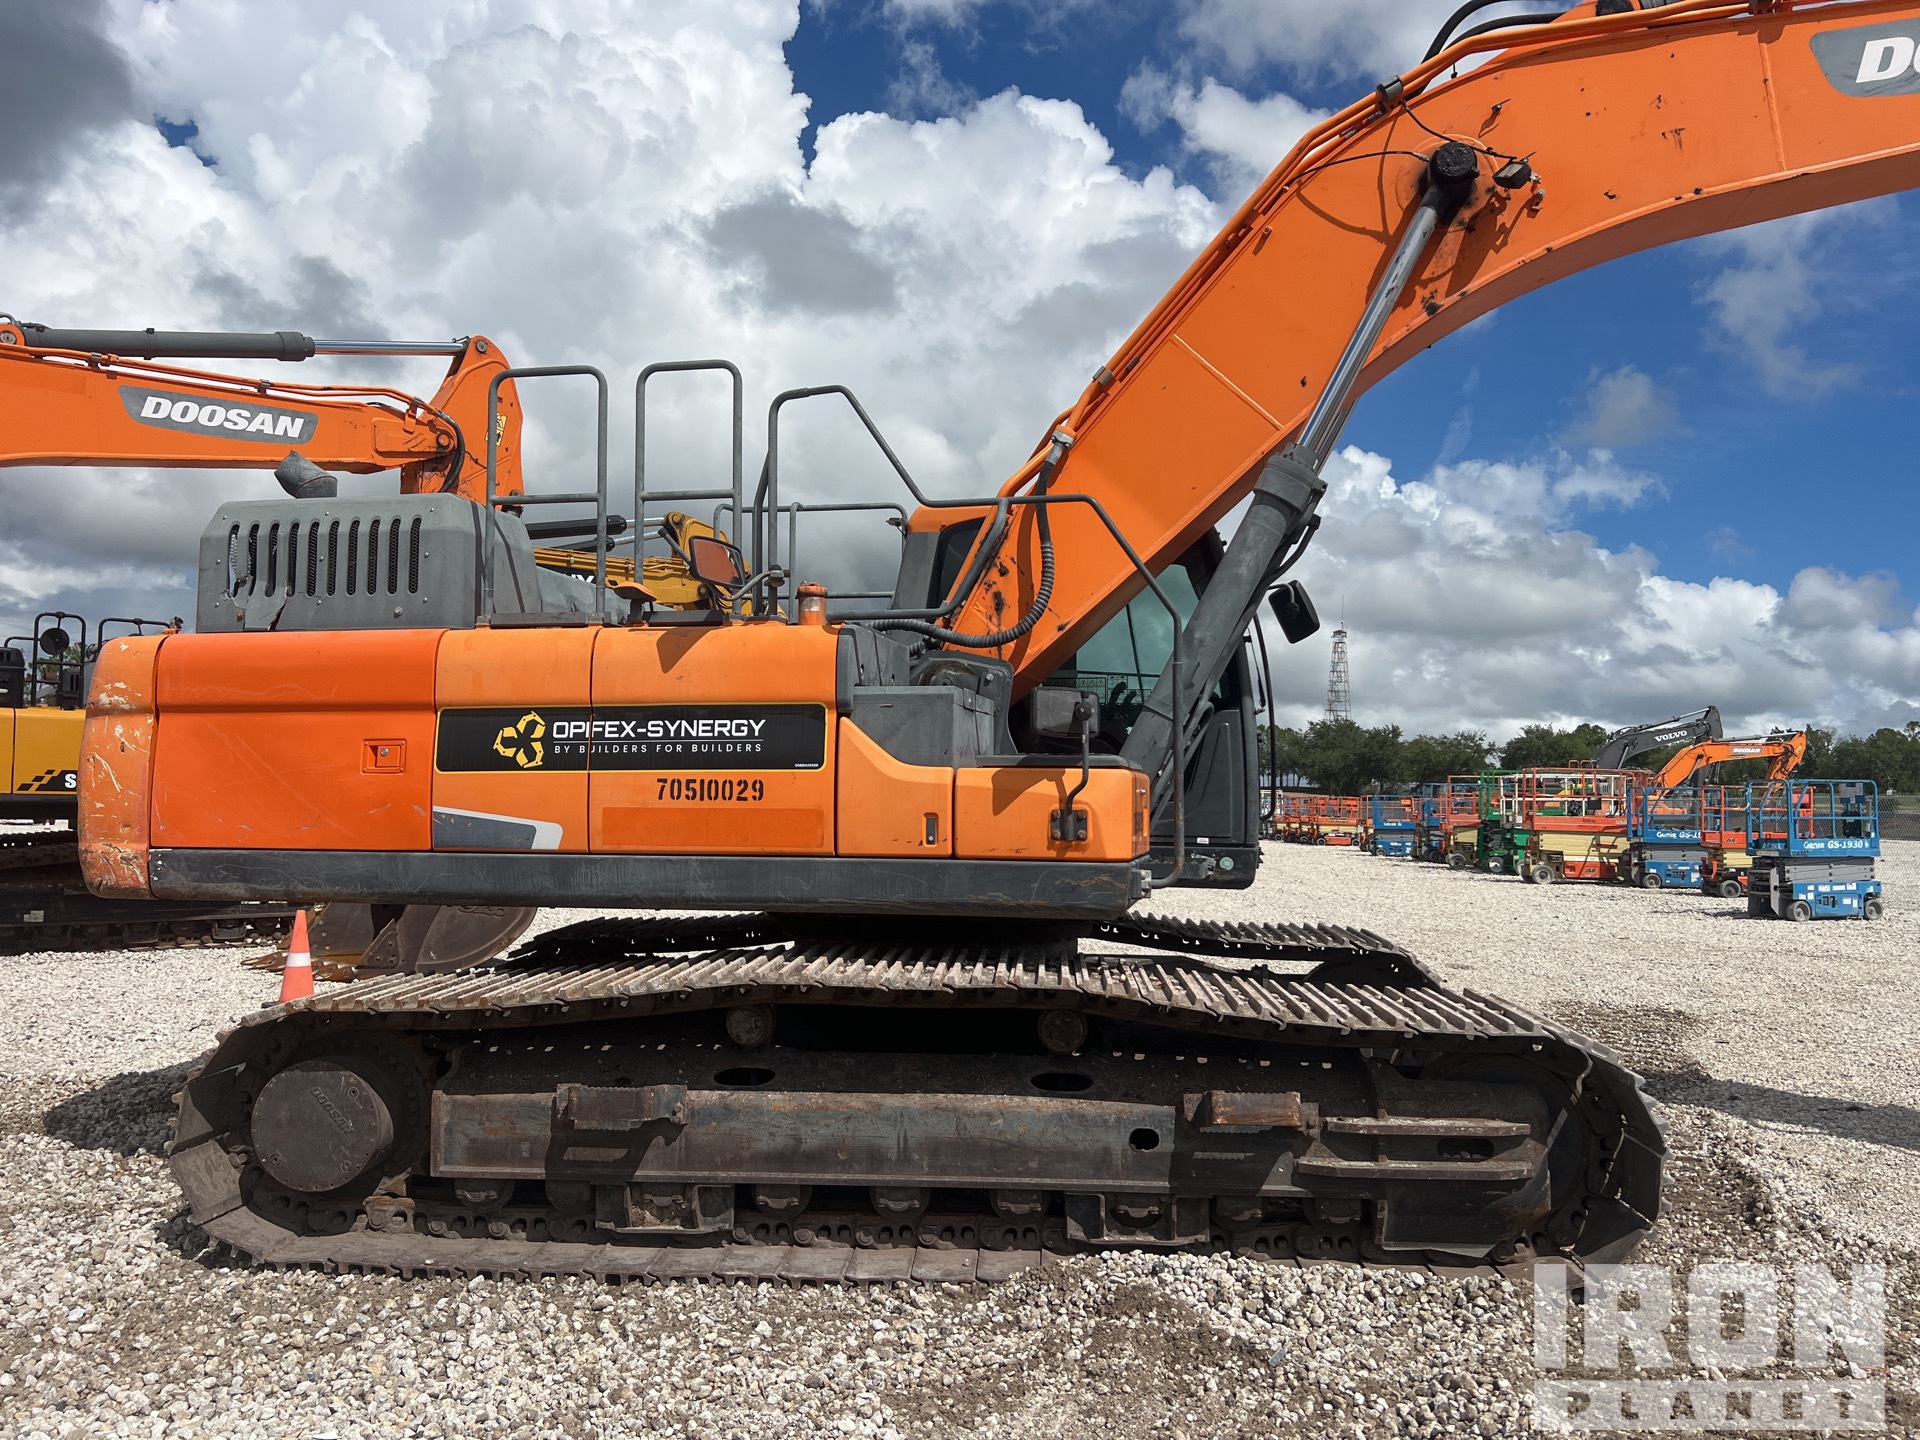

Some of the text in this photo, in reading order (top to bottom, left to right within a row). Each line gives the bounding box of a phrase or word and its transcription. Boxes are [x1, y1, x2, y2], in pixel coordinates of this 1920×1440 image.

[1856, 36, 1920, 83] D
[141, 396, 304, 438] DOOSAN
[553, 719, 766, 738] OPIFEX-SYNERGY
[1654, 730, 1688, 742] VOLVO
[555, 743, 762, 753] BY BUILDERS FOR BUILDERS
[64, 773, 77, 789] S
[657, 778, 764, 801] 70510029
[1656, 831, 1677, 839] Genie
[1803, 840, 1863, 849] Genie GS-1930
